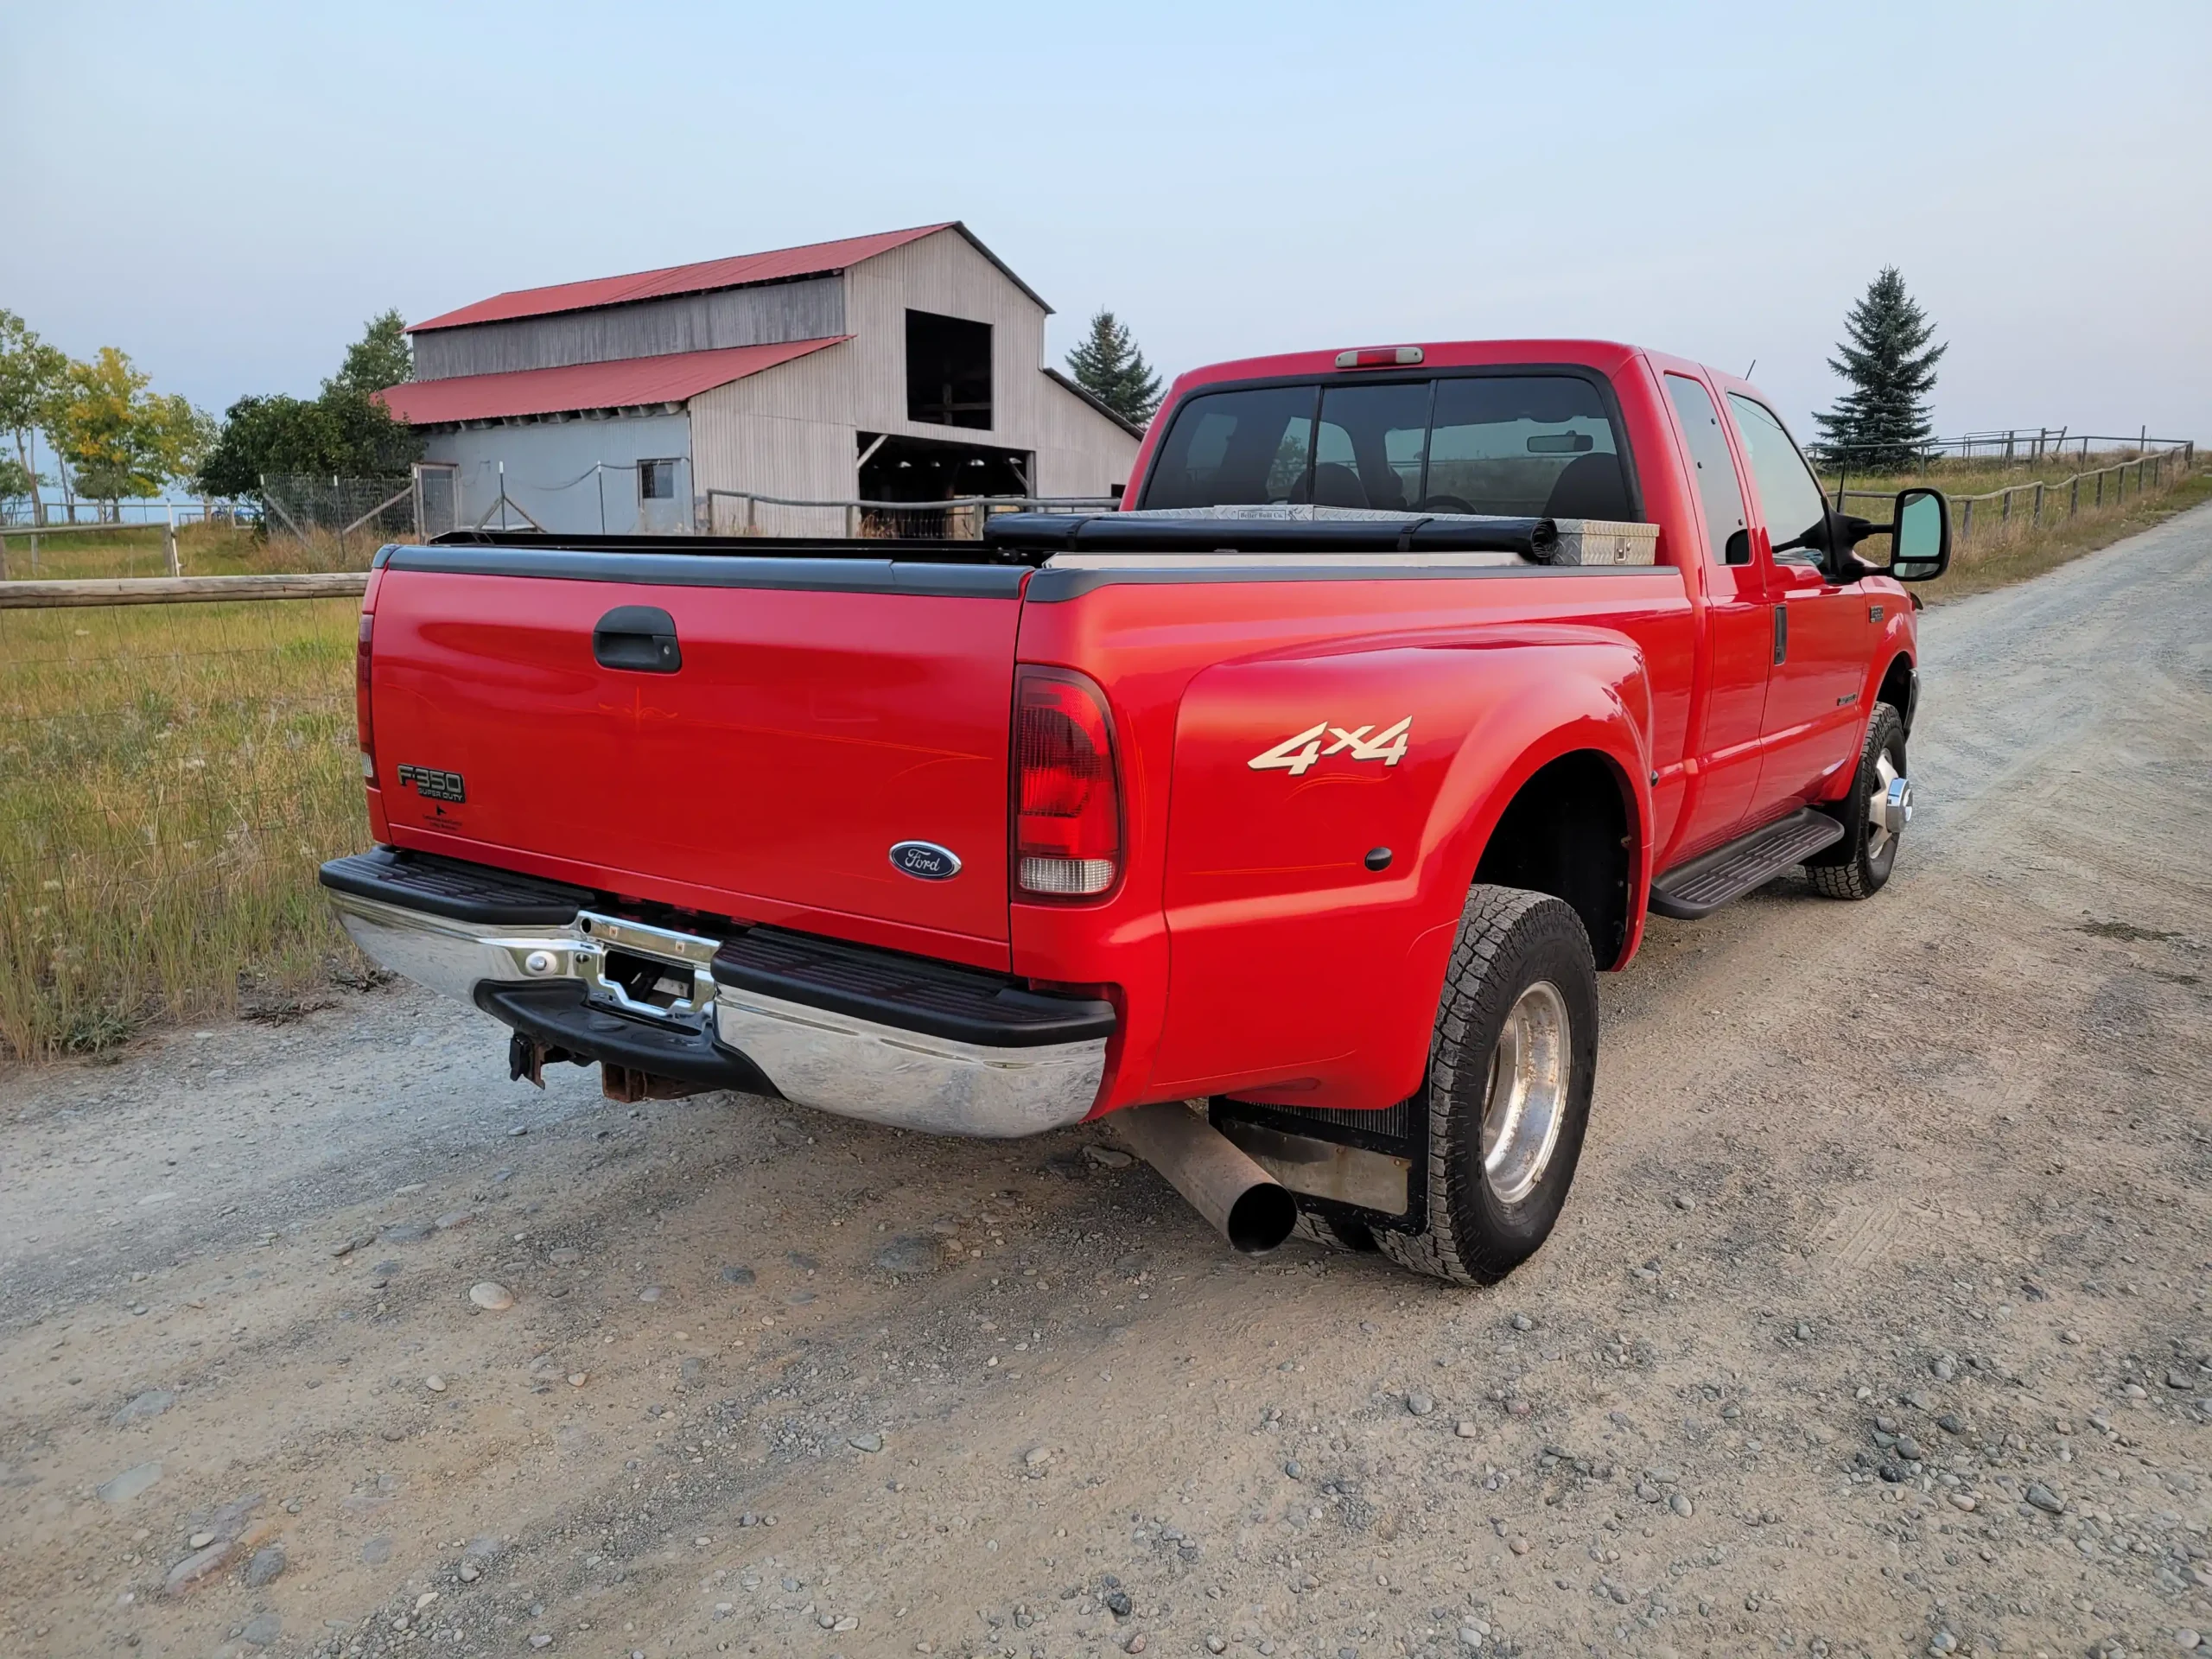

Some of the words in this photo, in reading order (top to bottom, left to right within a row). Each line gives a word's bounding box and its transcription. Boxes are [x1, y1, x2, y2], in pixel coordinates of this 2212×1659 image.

[418, 787, 441, 798] SUPER
[442, 791, 462, 801] DUTY
[905, 849, 941, 871] Ford
